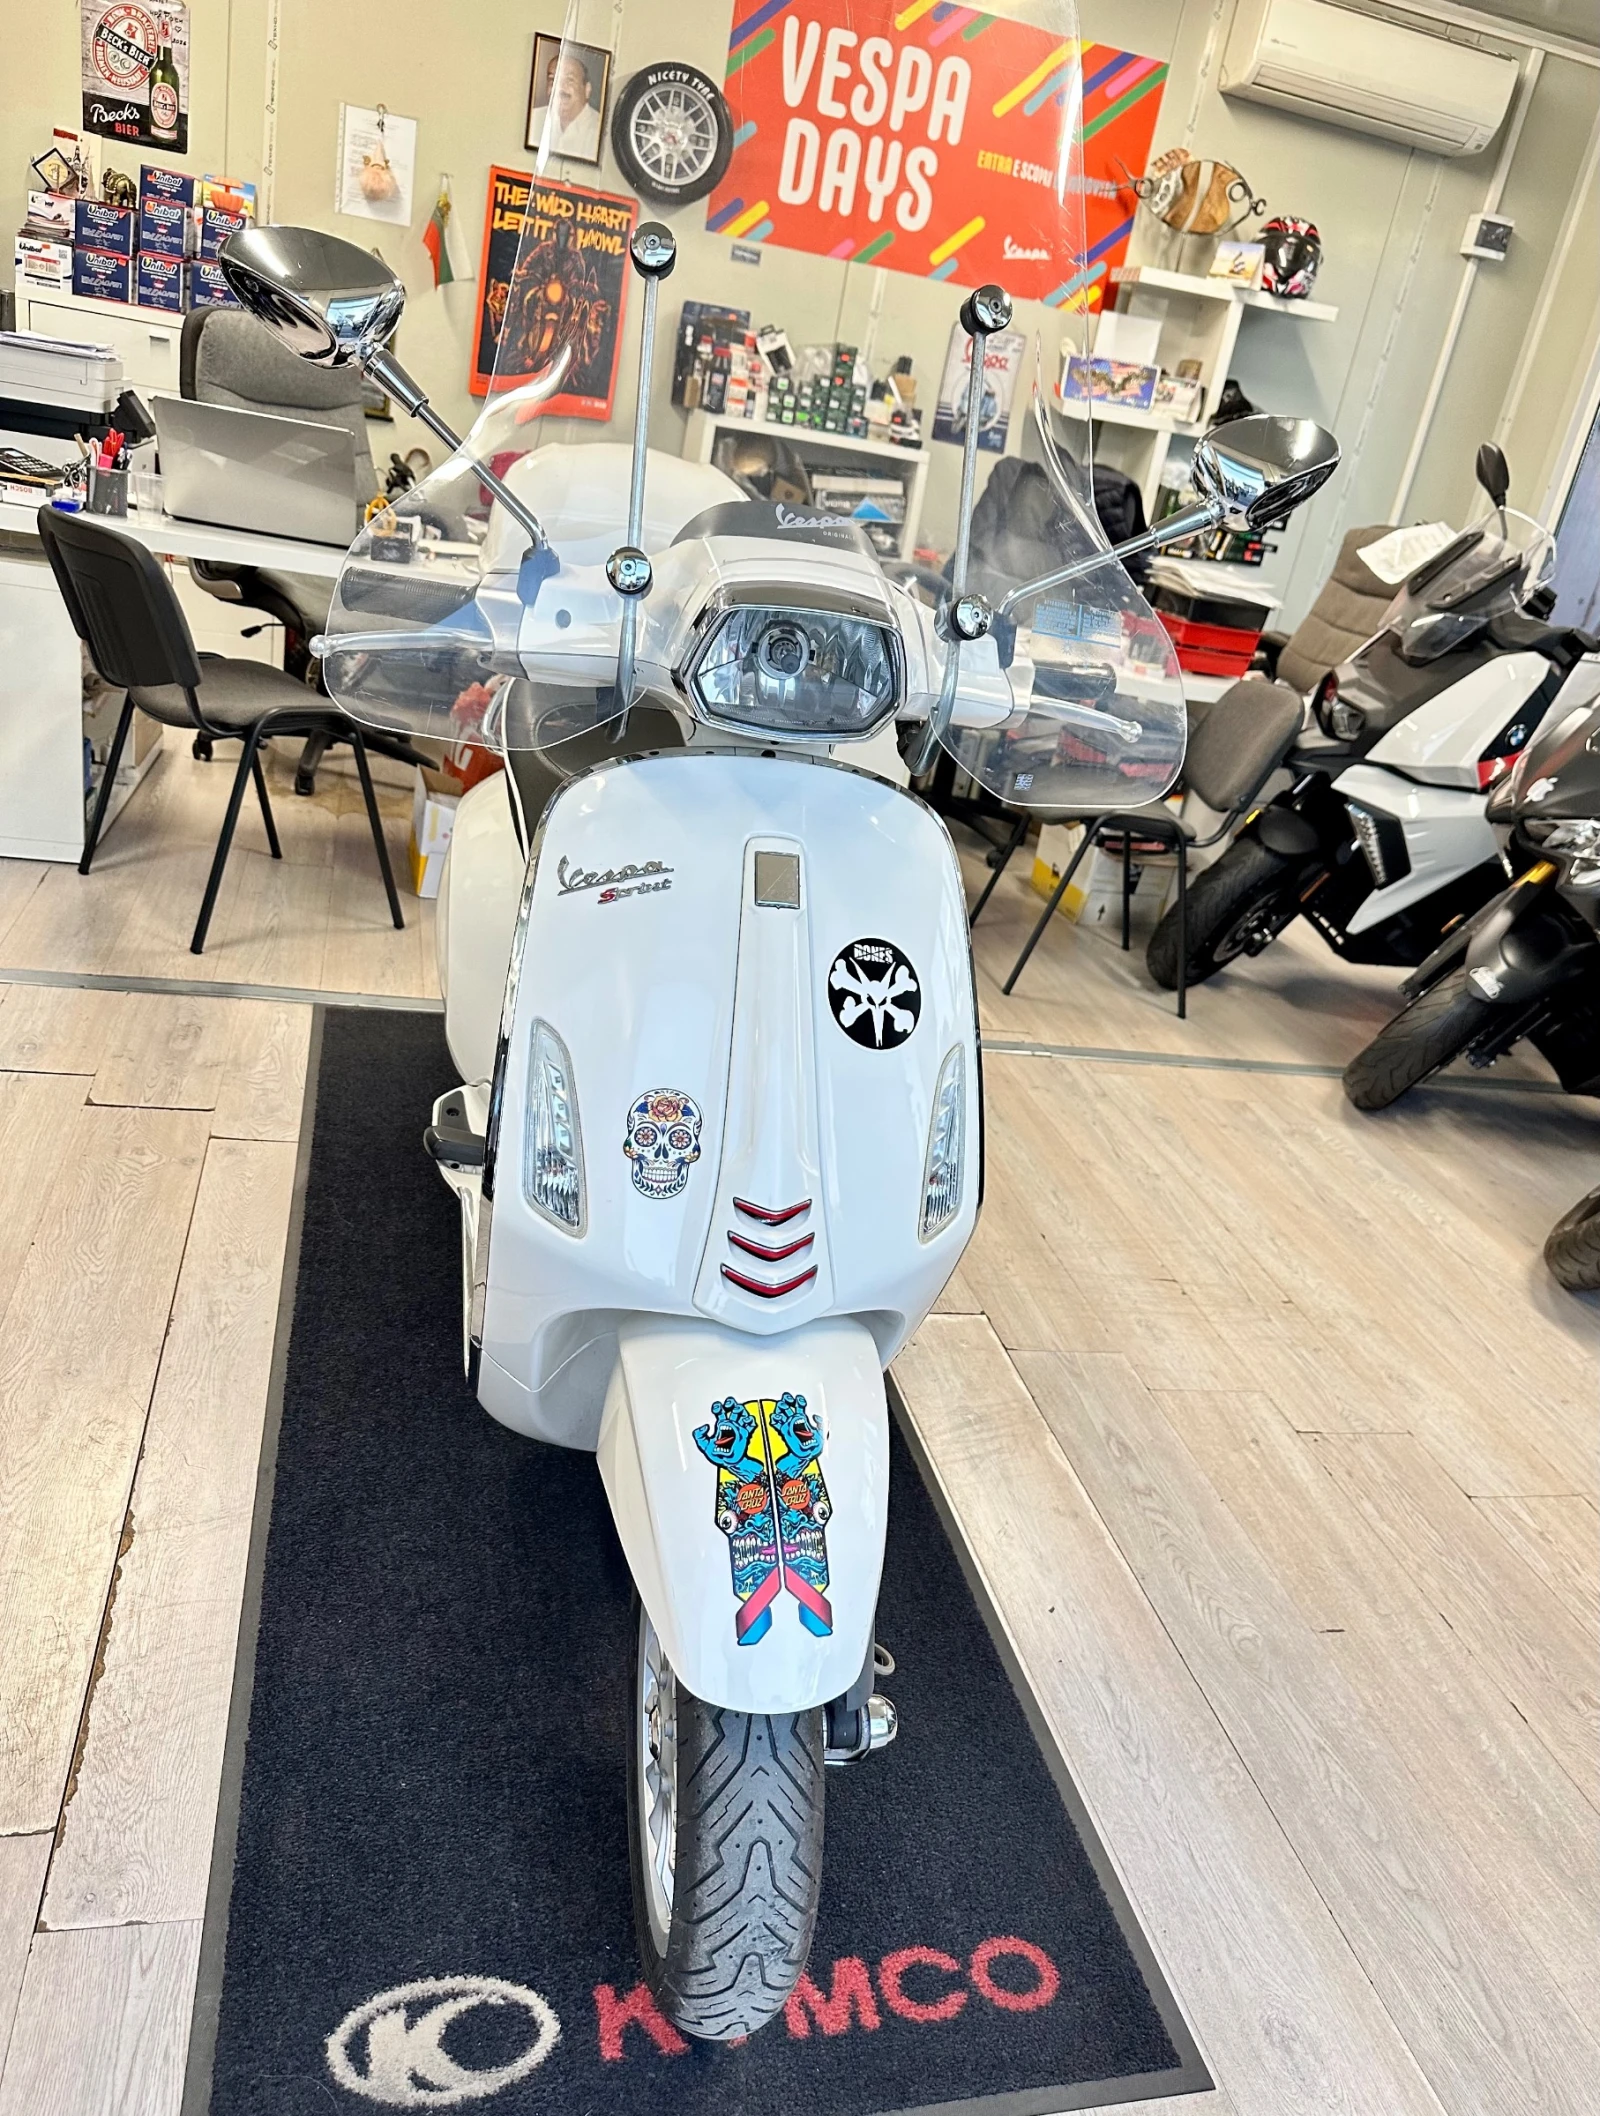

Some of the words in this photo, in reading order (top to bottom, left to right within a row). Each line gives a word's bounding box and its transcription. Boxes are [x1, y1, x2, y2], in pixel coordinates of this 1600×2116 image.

[129, 47, 151, 66] BIER
[647, 70, 689, 85] NICETY
[691, 77, 715, 101] TYRE
[782, 14, 972, 146] VESPA
[90, 103, 141, 123] Beck's
[114, 122, 140, 137] BIER
[977, 150, 1013, 175] ENTRA
[1012, 159, 1021, 177] E
[153, 170, 182, 187] Unibat
[777, 117, 938, 232] DAYS
[495, 181, 530, 206] THE
[87, 203, 118, 219] Unibat
[18, 241, 43, 253] Unibat
[1002, 235, 1051, 261] Vespa
[86, 253, 117, 269] Unibat
[200, 264, 224, 281] Unib
[10, 484, 33, 494] BOSCH
[775, 503, 855, 529] Vespa
[557, 854, 675, 896] Vespa
[597, 878, 673, 905] Sprint
[853, 943, 894, 964] BONES
[735, 1486, 764, 1502] SANTA
[781, 1481, 807, 1497] SANTA
[741, 1498, 764, 1511] CRUZ
[786, 1493, 807, 1506] CRUZ
[594, 1934, 1060, 2062] KMCO
